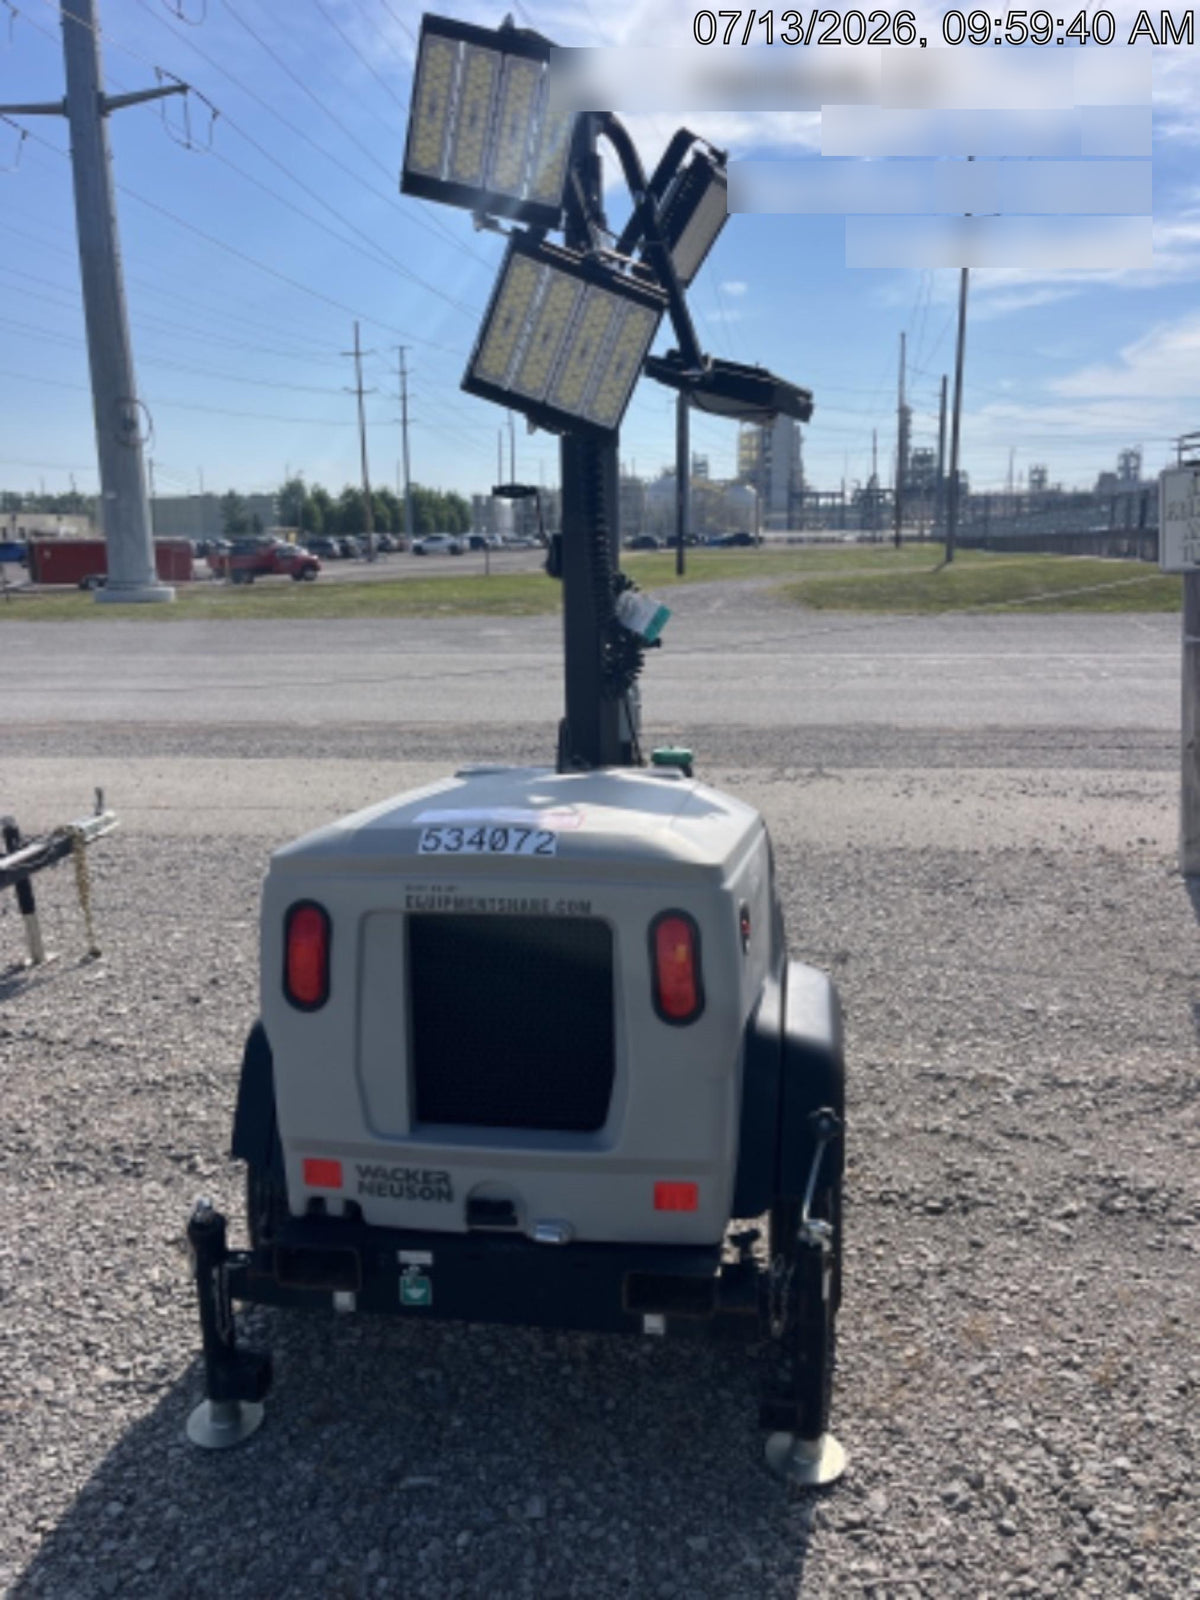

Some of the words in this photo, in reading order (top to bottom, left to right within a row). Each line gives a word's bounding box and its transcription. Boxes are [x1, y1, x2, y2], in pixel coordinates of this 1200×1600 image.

[420, 827, 557, 855] 534072
[355, 1163, 451, 1186] WACKER
[357, 1180, 454, 1203] NEUSON
